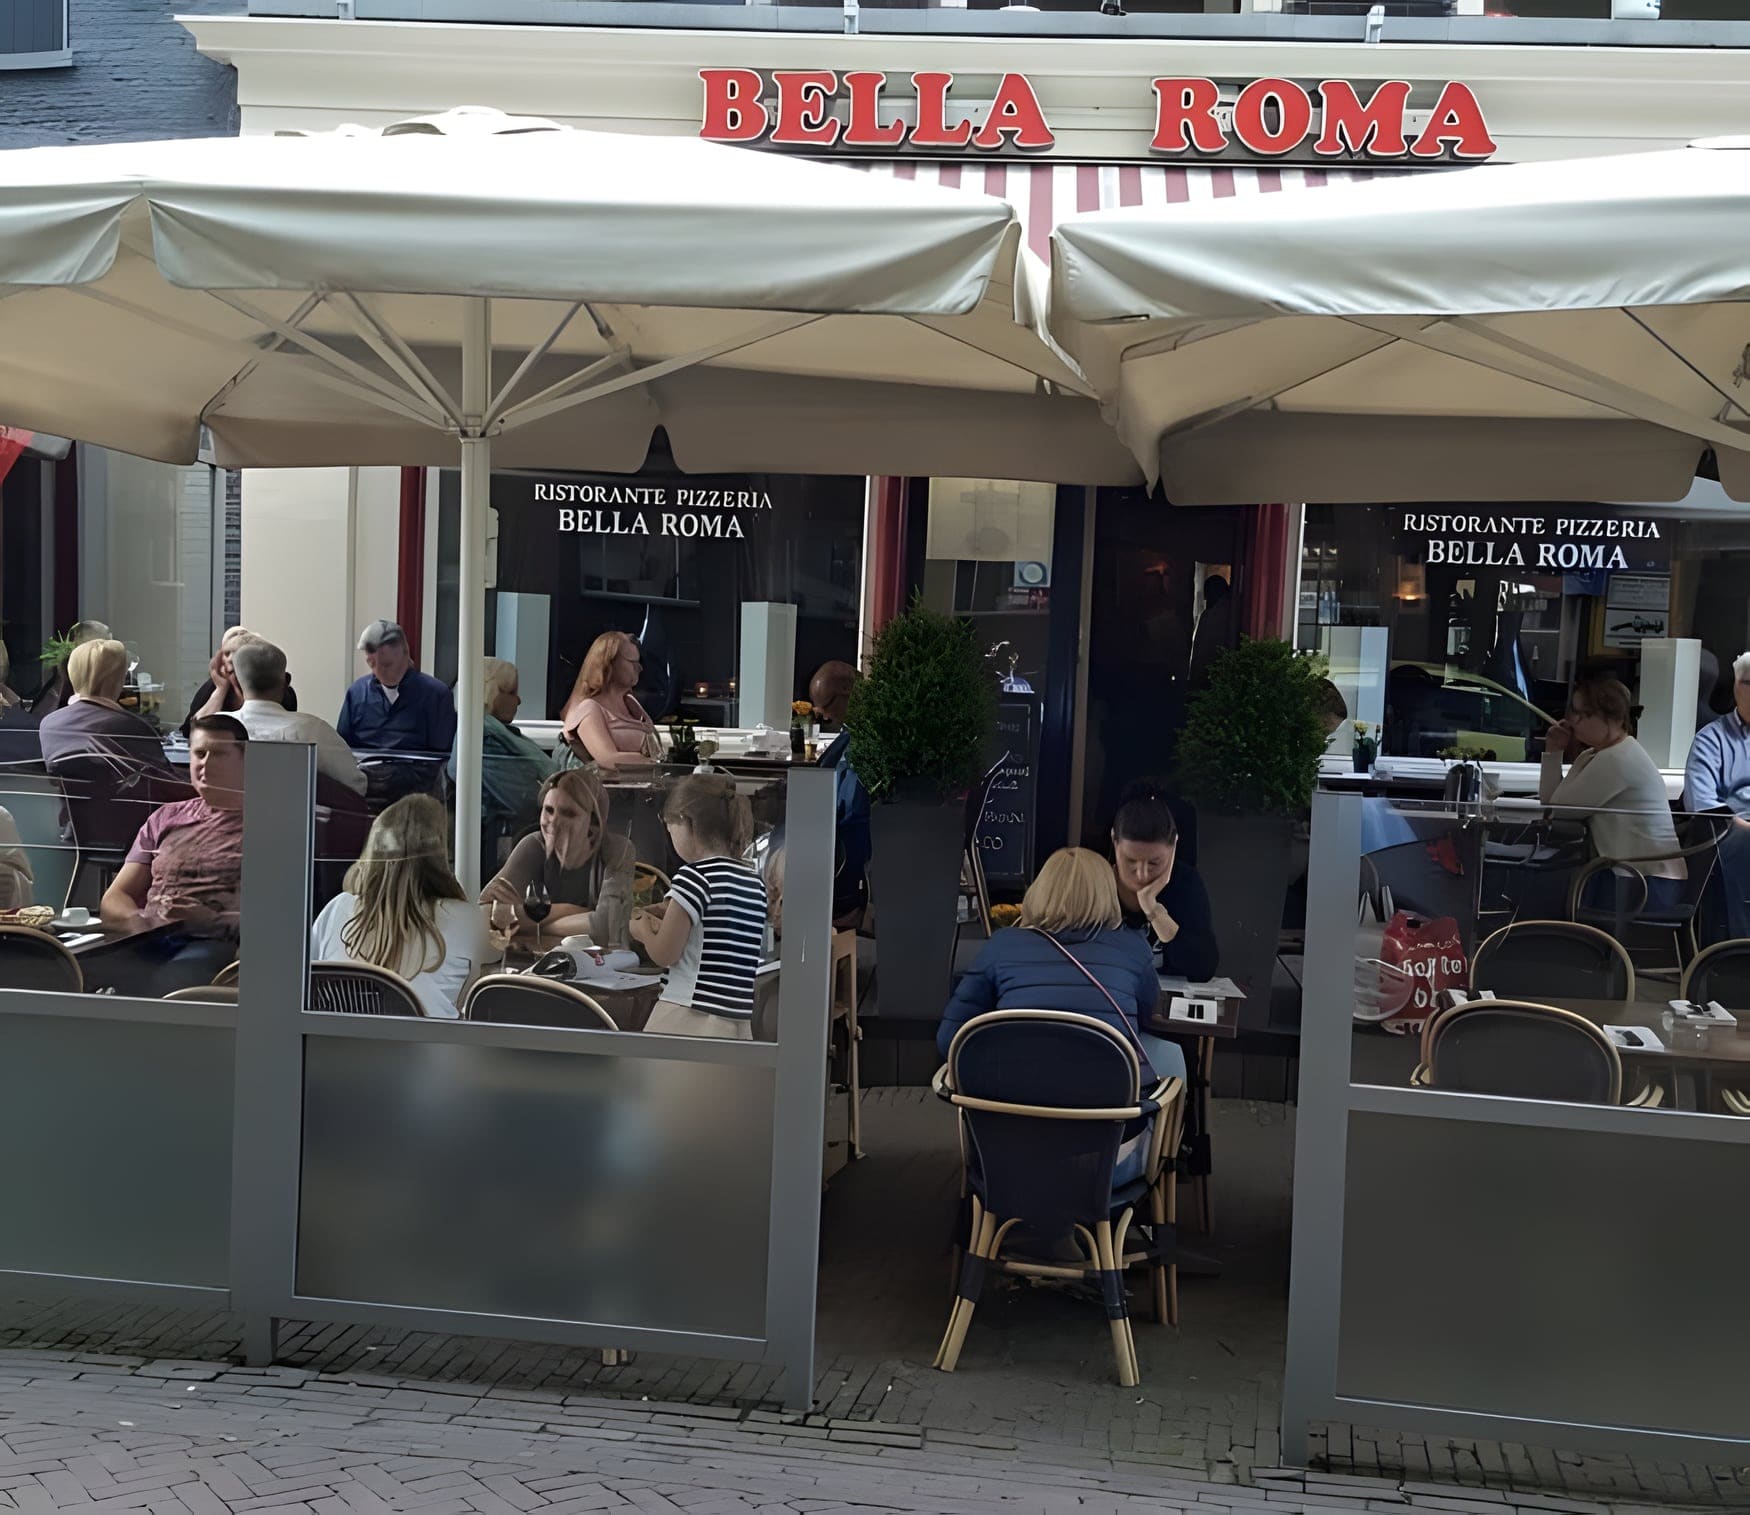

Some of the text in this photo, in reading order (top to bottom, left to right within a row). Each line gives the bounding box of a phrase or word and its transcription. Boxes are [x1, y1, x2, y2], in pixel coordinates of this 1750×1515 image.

[699, 69, 1498, 158] BELLA ROMA
[534, 483, 773, 509] RISTORANTE PIZZERIA
[558, 508, 745, 538] BELLA ROMA
[1403, 513, 1661, 539] RISTORANTE PIZZERIA
[1426, 539, 1629, 569] BELLA ROMA
